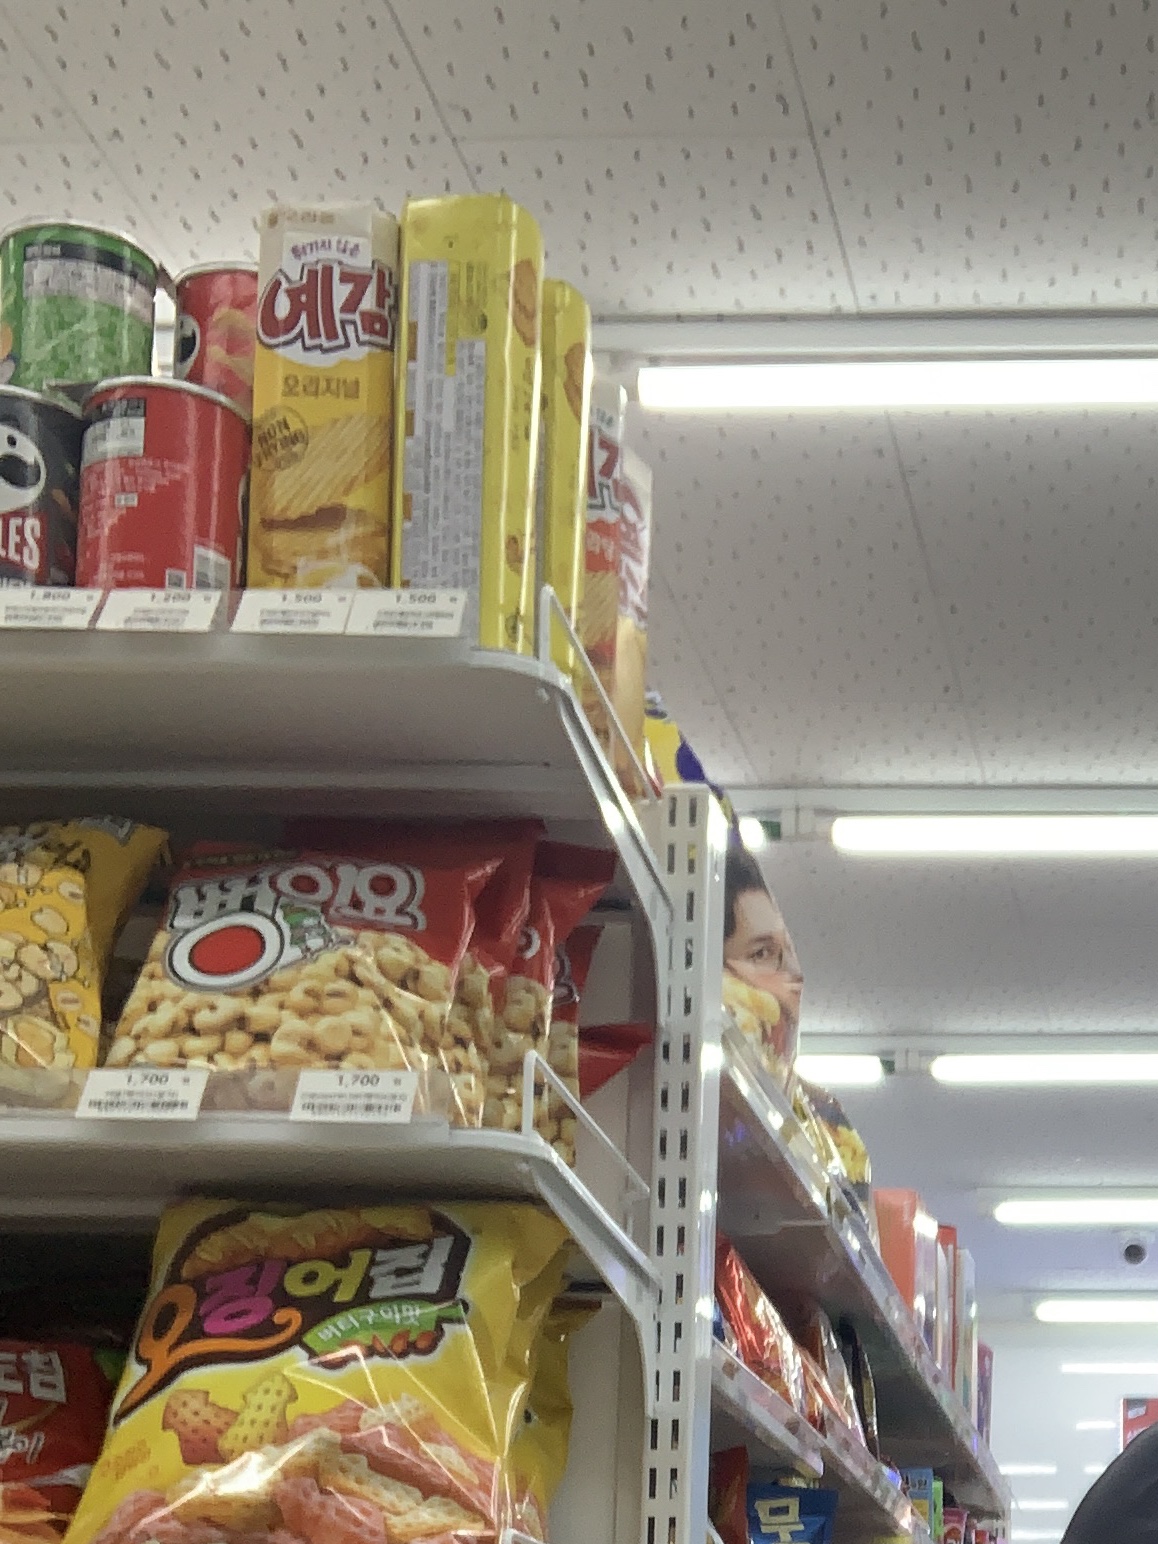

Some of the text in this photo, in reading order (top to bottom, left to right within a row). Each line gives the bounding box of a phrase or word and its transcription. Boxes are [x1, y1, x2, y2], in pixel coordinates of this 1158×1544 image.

[257, 259, 397, 351] 예감
[282, 374, 360, 399] 오리지널
[0, 515, 41, 572] ES
[126, 1073, 170, 1087] 1,700
[336, 1074, 381, 1089] 1,700
[112, 1236, 456, 1420] 오징어집
